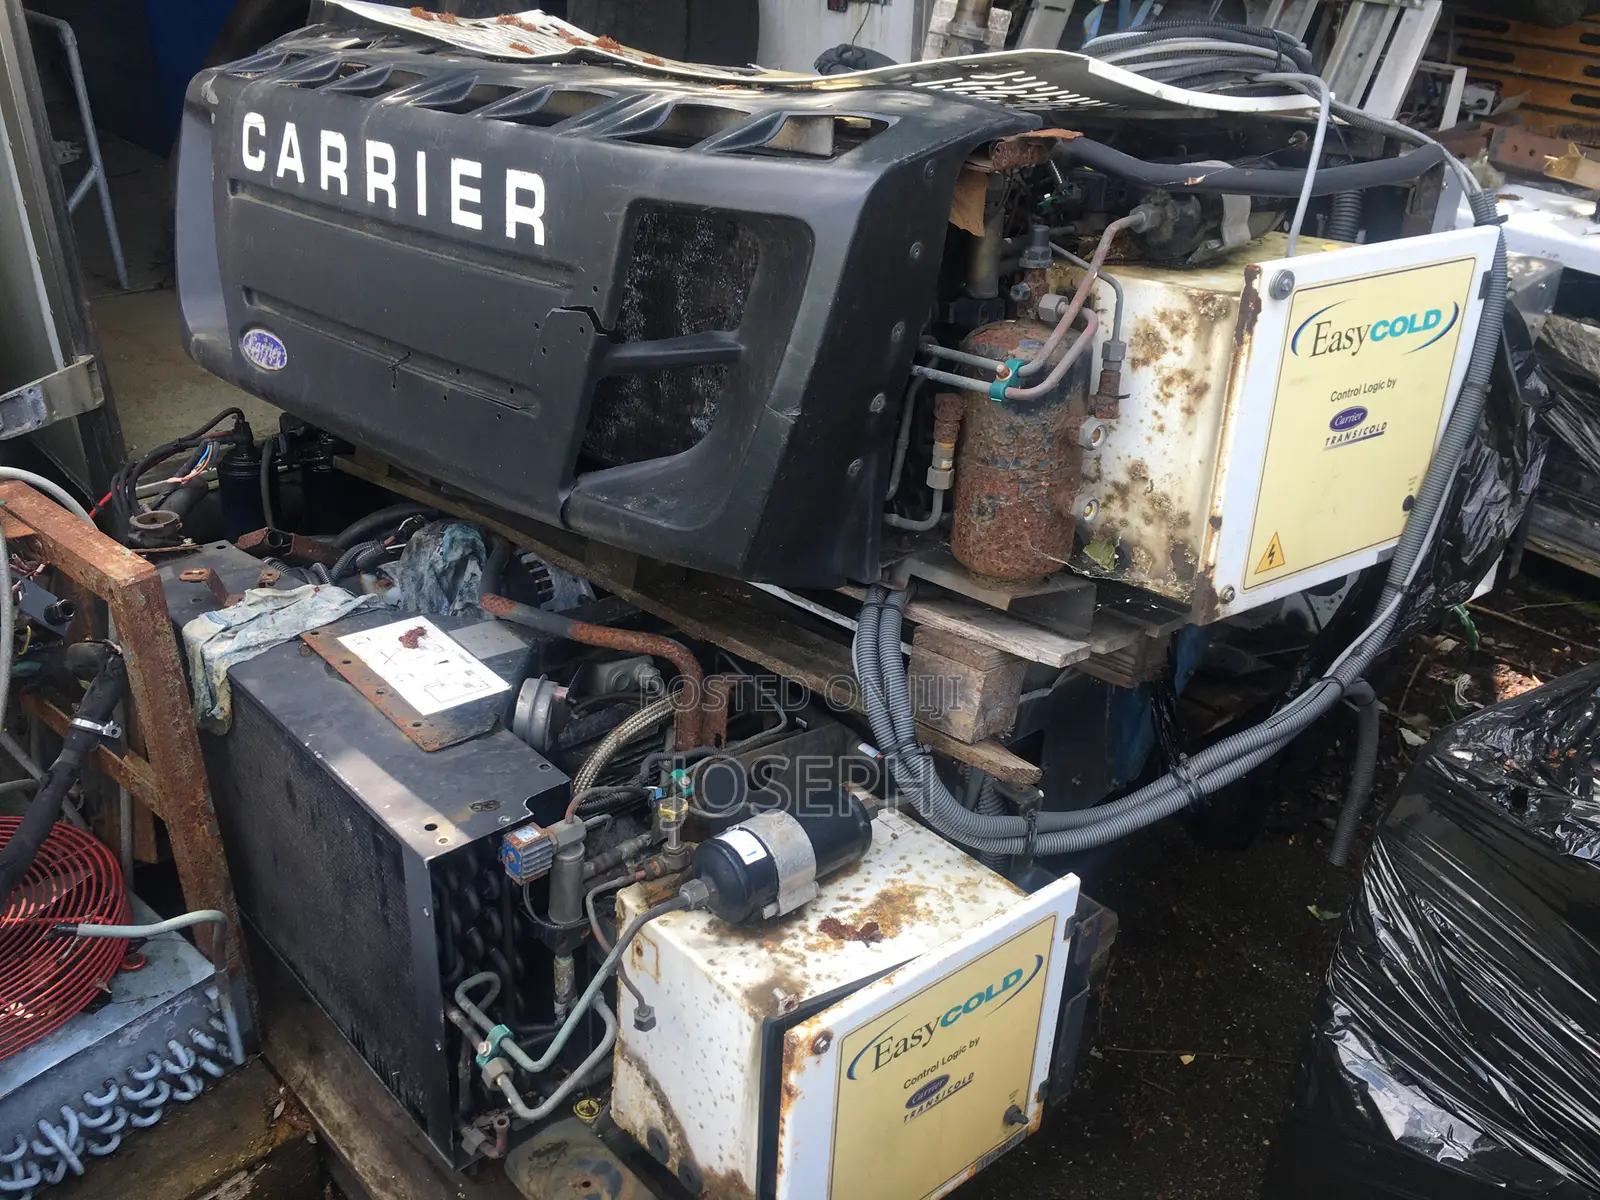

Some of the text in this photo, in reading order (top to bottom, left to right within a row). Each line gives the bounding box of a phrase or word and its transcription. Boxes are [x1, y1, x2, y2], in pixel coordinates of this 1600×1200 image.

[242, 111, 546, 247] CARRIER
[1308, 308, 1442, 358] EasyCOLD
[1330, 377, 1397, 402] Control Logic by
[1325, 421, 1388, 446] TRANSICOLD
[1334, 410, 1364, 427] Carrier
[871, 968, 1024, 1073] EasyCOLD
[903, 1036, 981, 1089] Control Logic by
[903, 1071, 975, 1124] TRANSICOLD
[911, 1077, 946, 1105] Carrier
